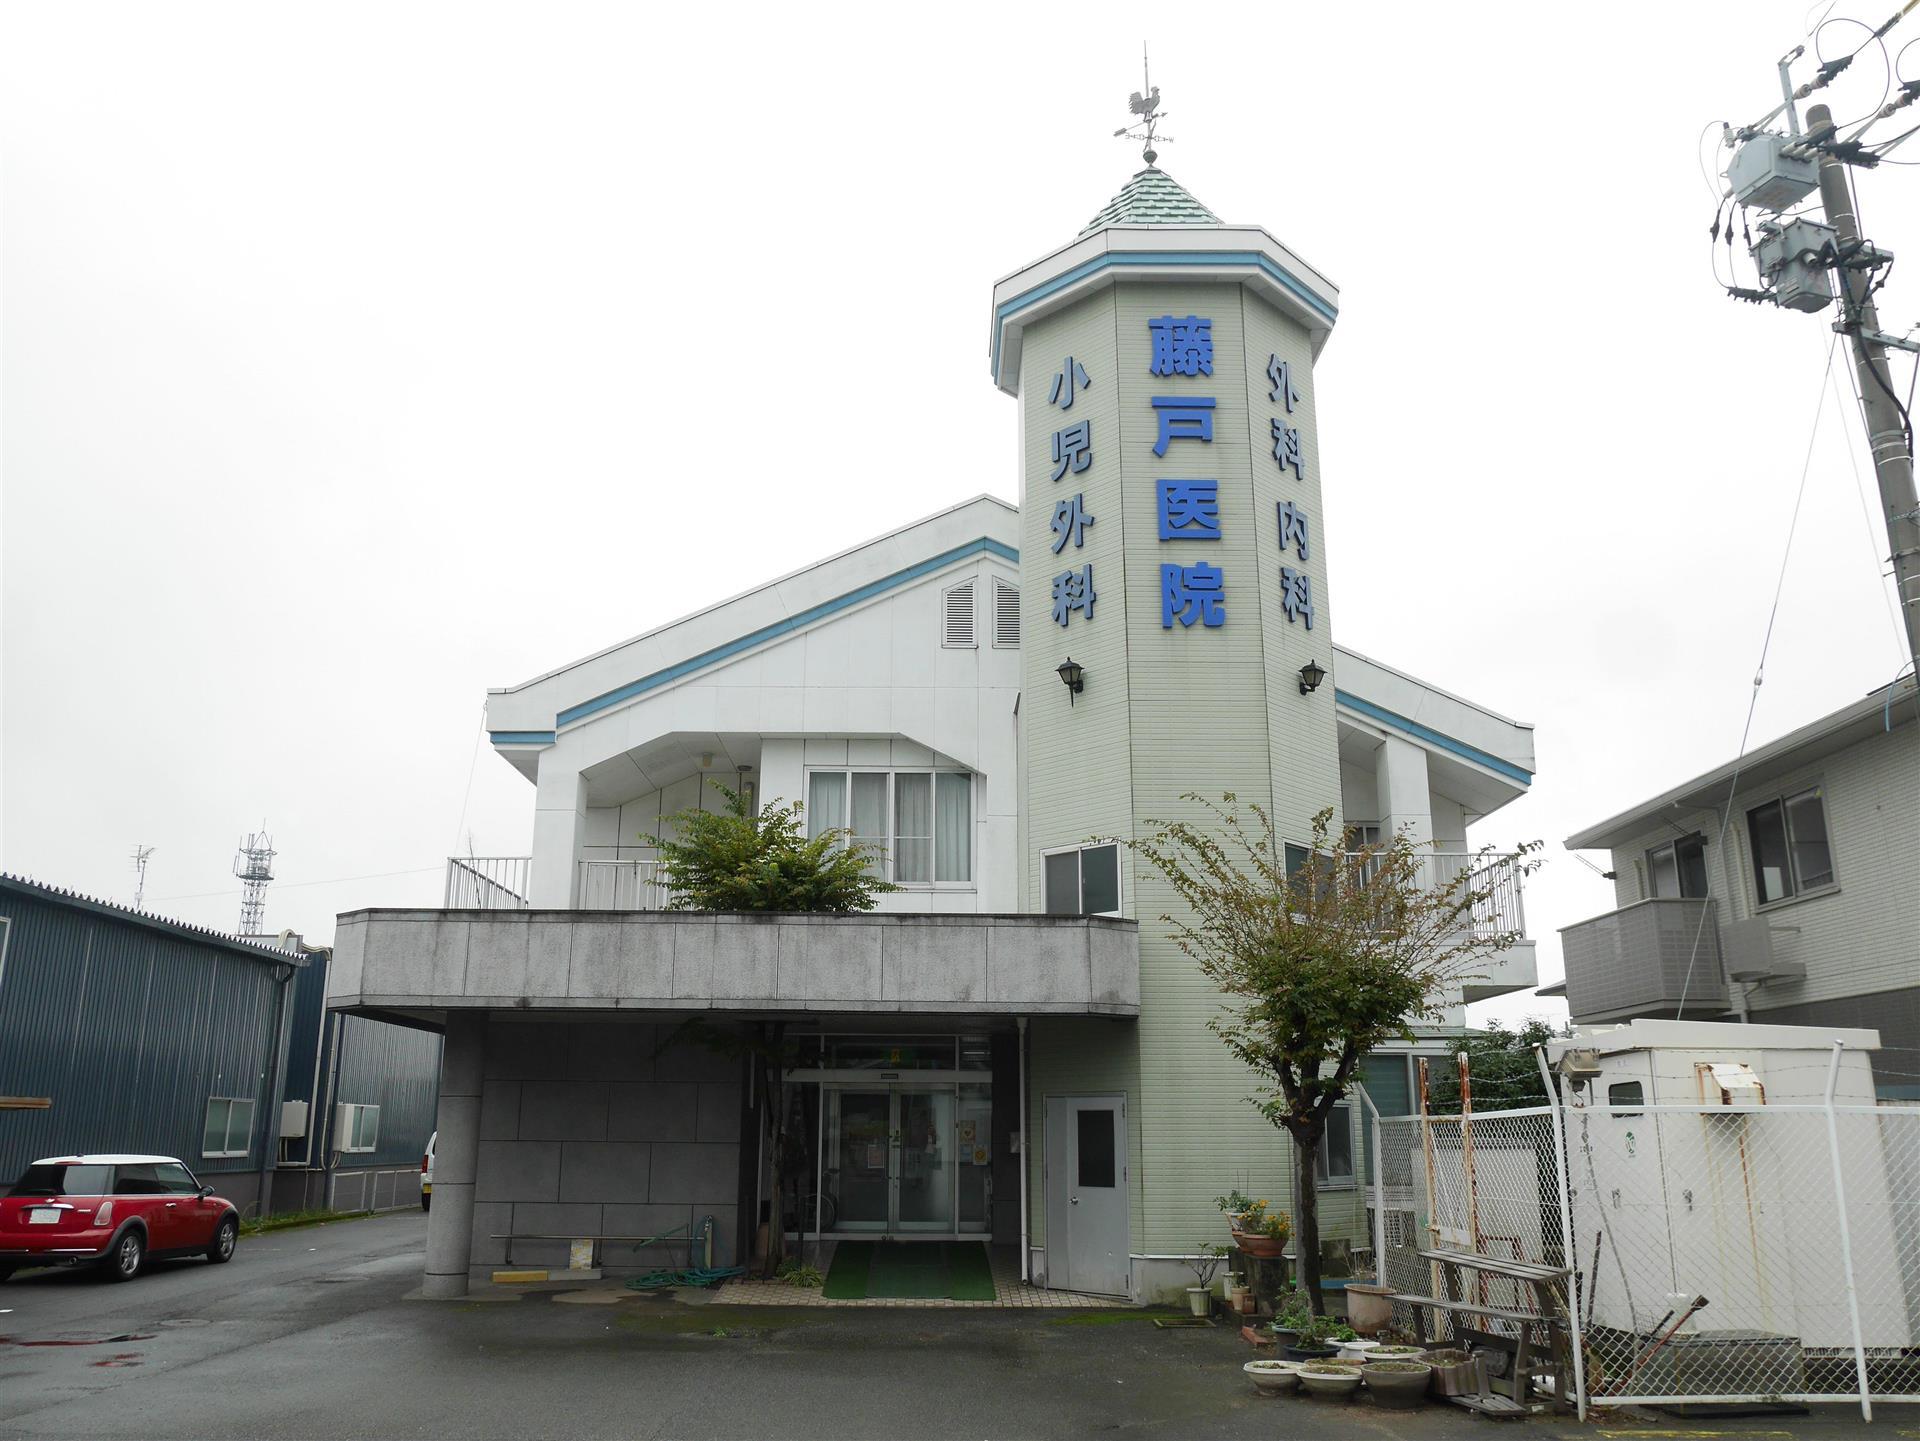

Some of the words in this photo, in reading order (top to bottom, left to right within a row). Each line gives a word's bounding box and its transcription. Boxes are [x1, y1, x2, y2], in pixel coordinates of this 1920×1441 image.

[1048, 356, 1097, 627] 小児外科
[1148, 315, 1226, 629] 藤戸医院
[1266, 353, 1305, 481] 外科
[1276, 500, 1315, 630] 内科
